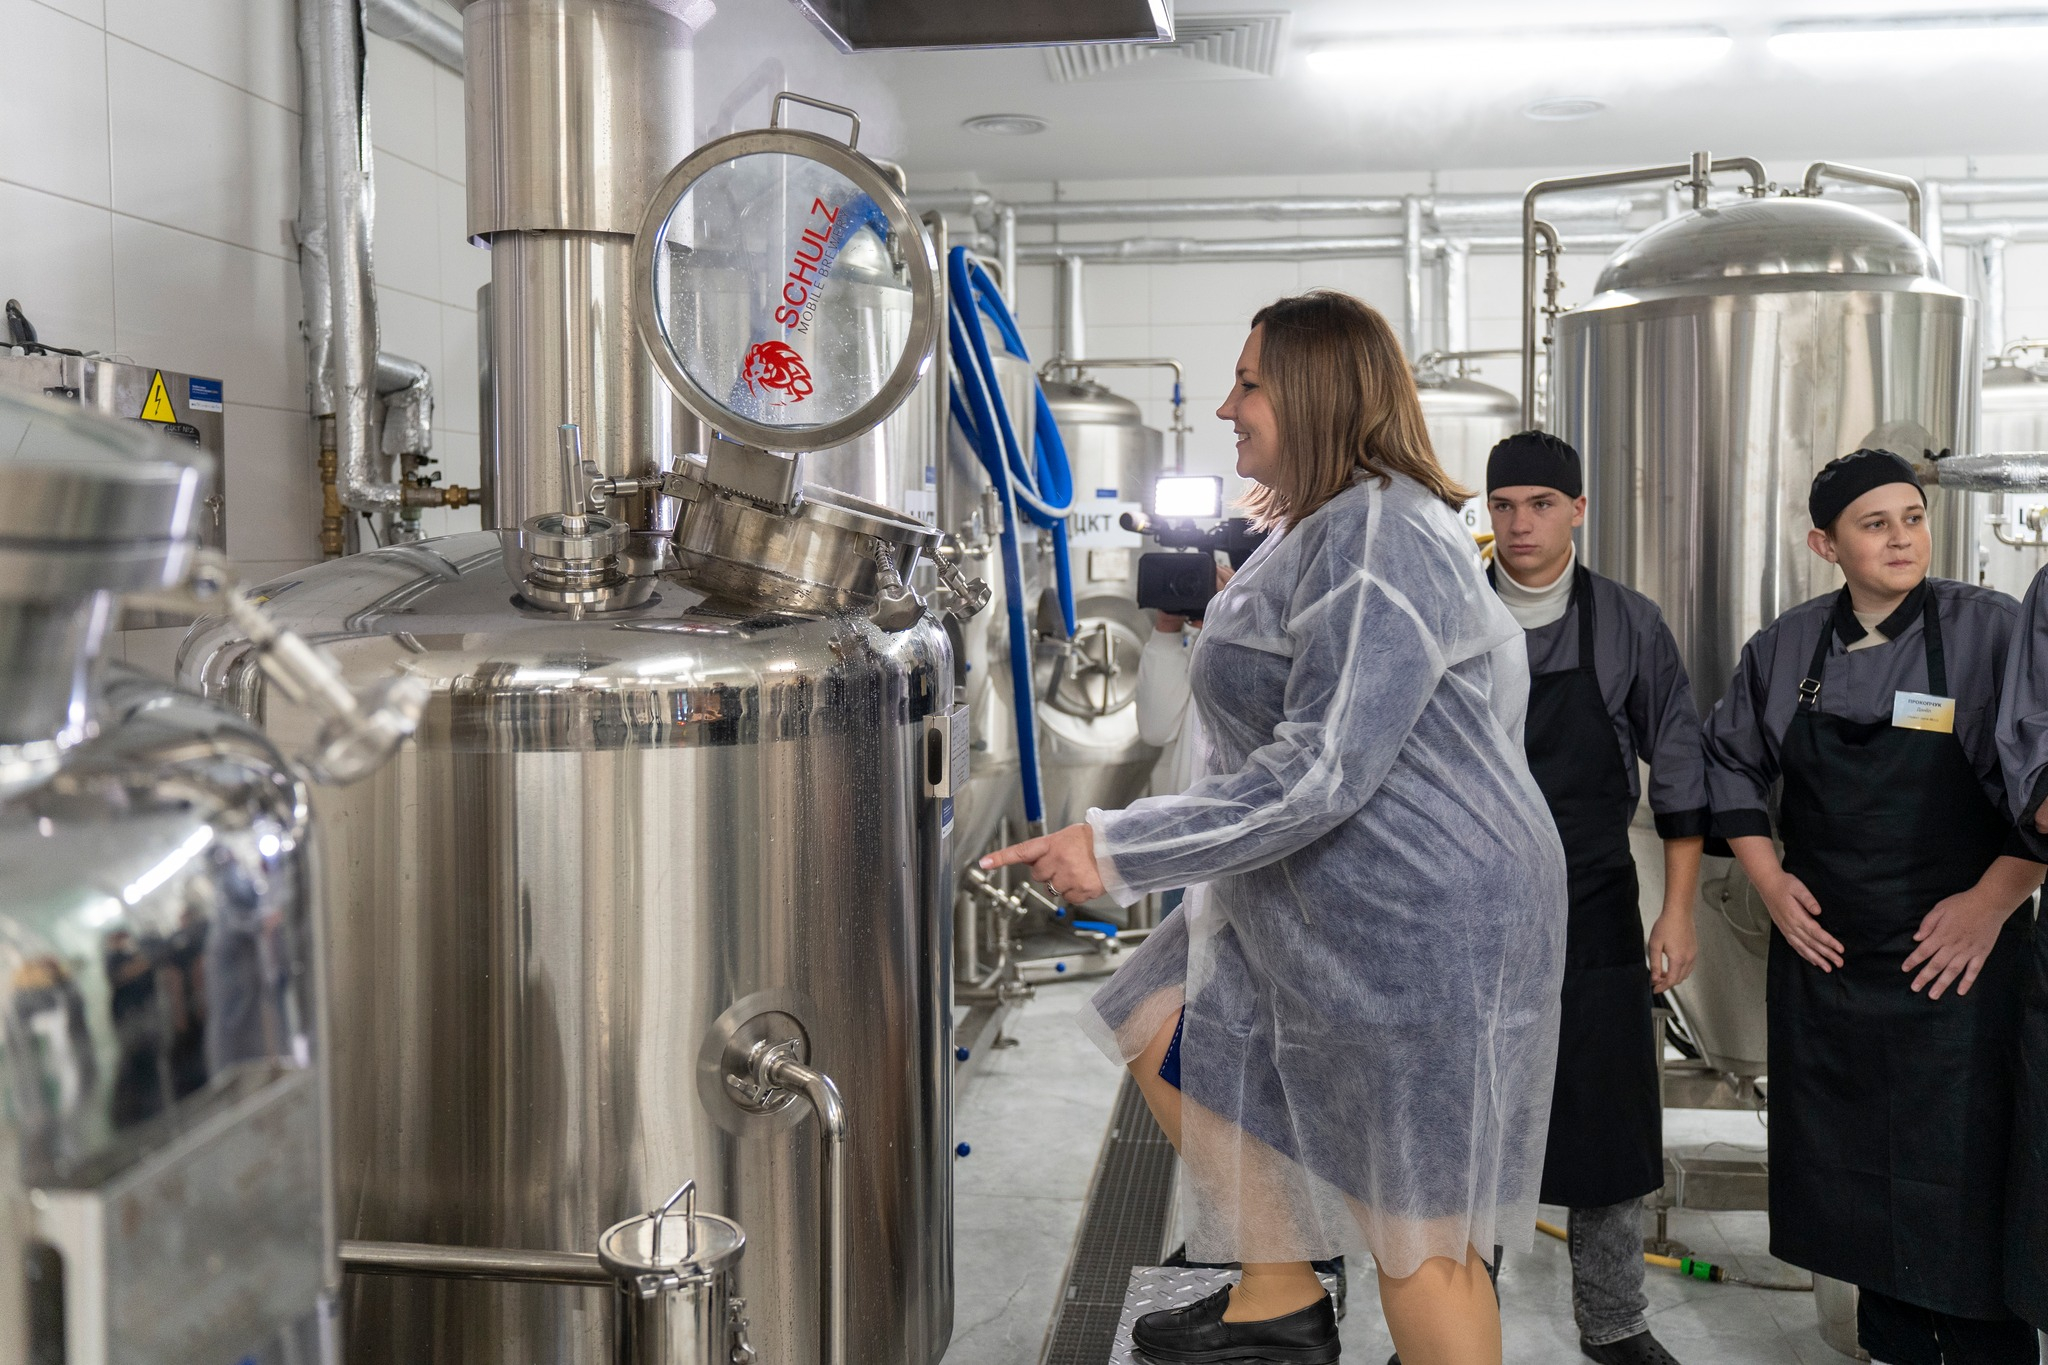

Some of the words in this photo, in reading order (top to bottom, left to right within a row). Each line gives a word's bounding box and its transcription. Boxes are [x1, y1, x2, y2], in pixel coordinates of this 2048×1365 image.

[774, 197, 840, 329] SCHULZ
[797, 280, 825, 335] MOBILE
[818, 210, 849, 278] BREWERY
[1465, 509, 1476, 527] 6
